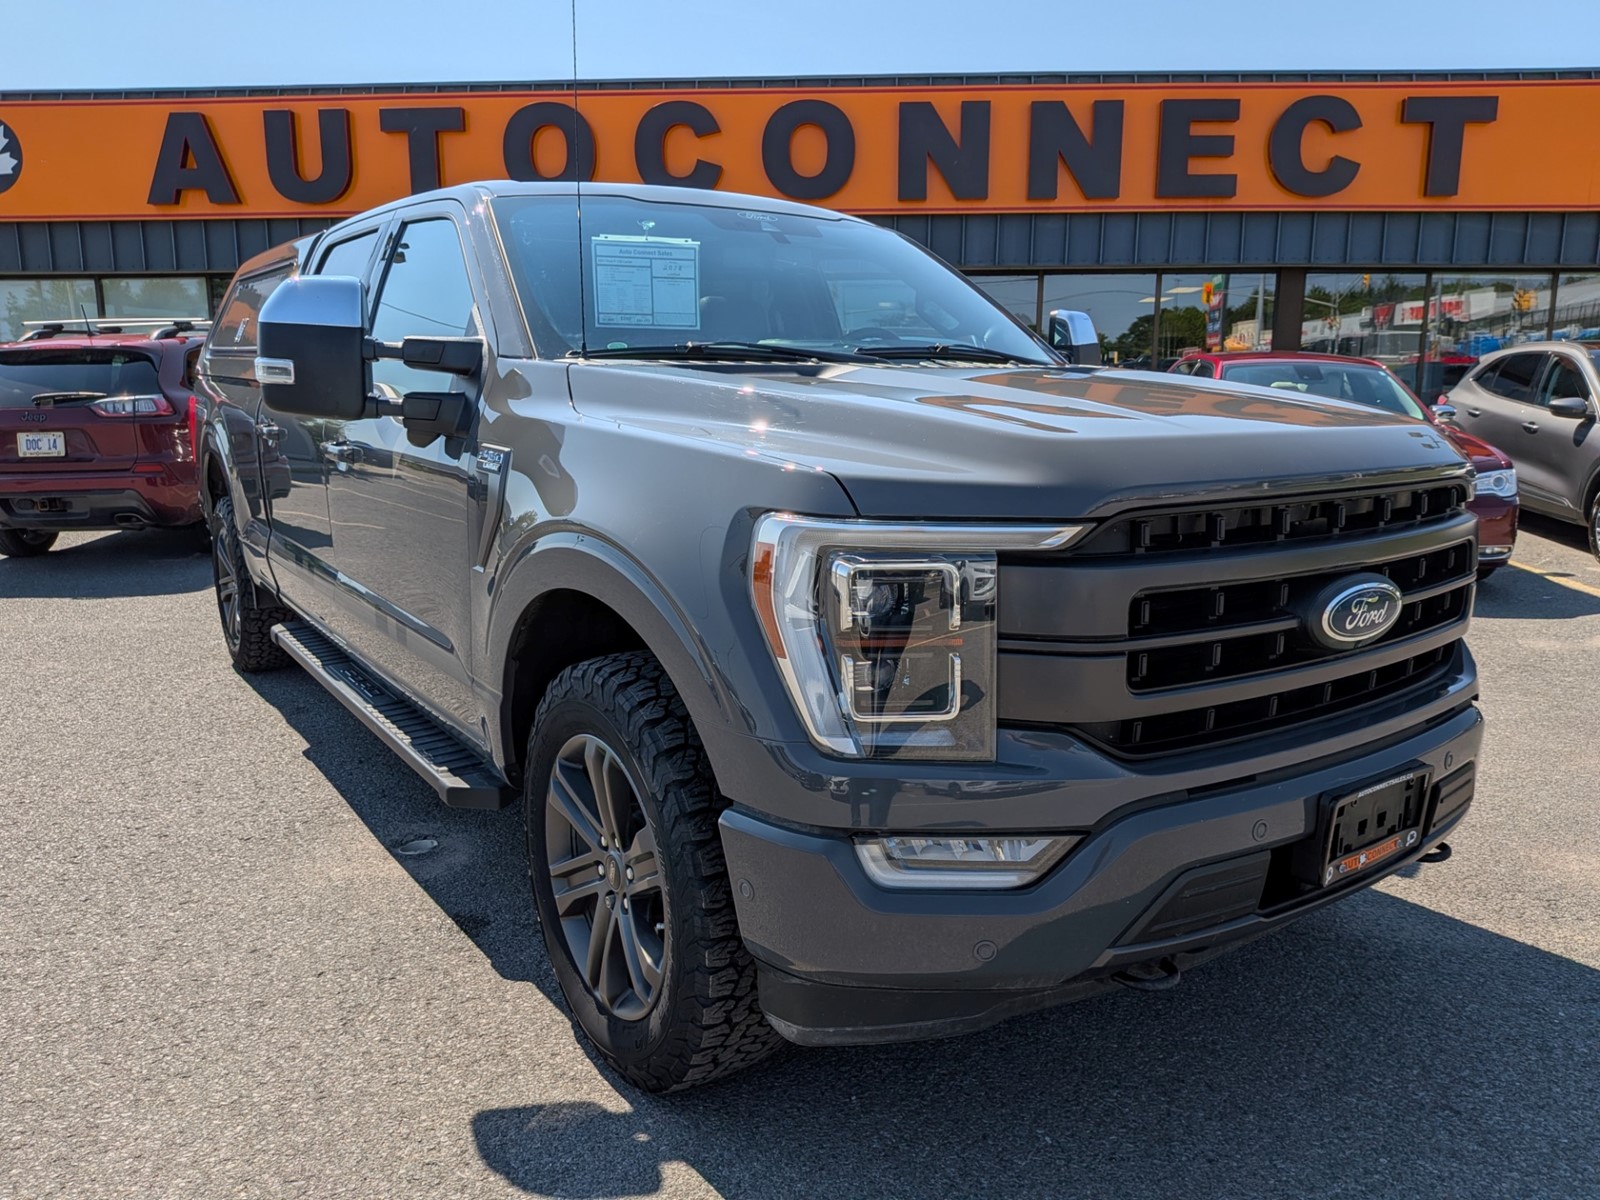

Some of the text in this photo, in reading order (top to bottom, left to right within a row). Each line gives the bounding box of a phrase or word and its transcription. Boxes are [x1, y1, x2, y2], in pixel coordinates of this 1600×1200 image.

[147, 96, 1499, 205] AUTOCONNECT
[21, 411, 46, 422] Jeep
[25, 439, 57, 450] DOC 14
[1346, 596, 1388, 630] Ford
